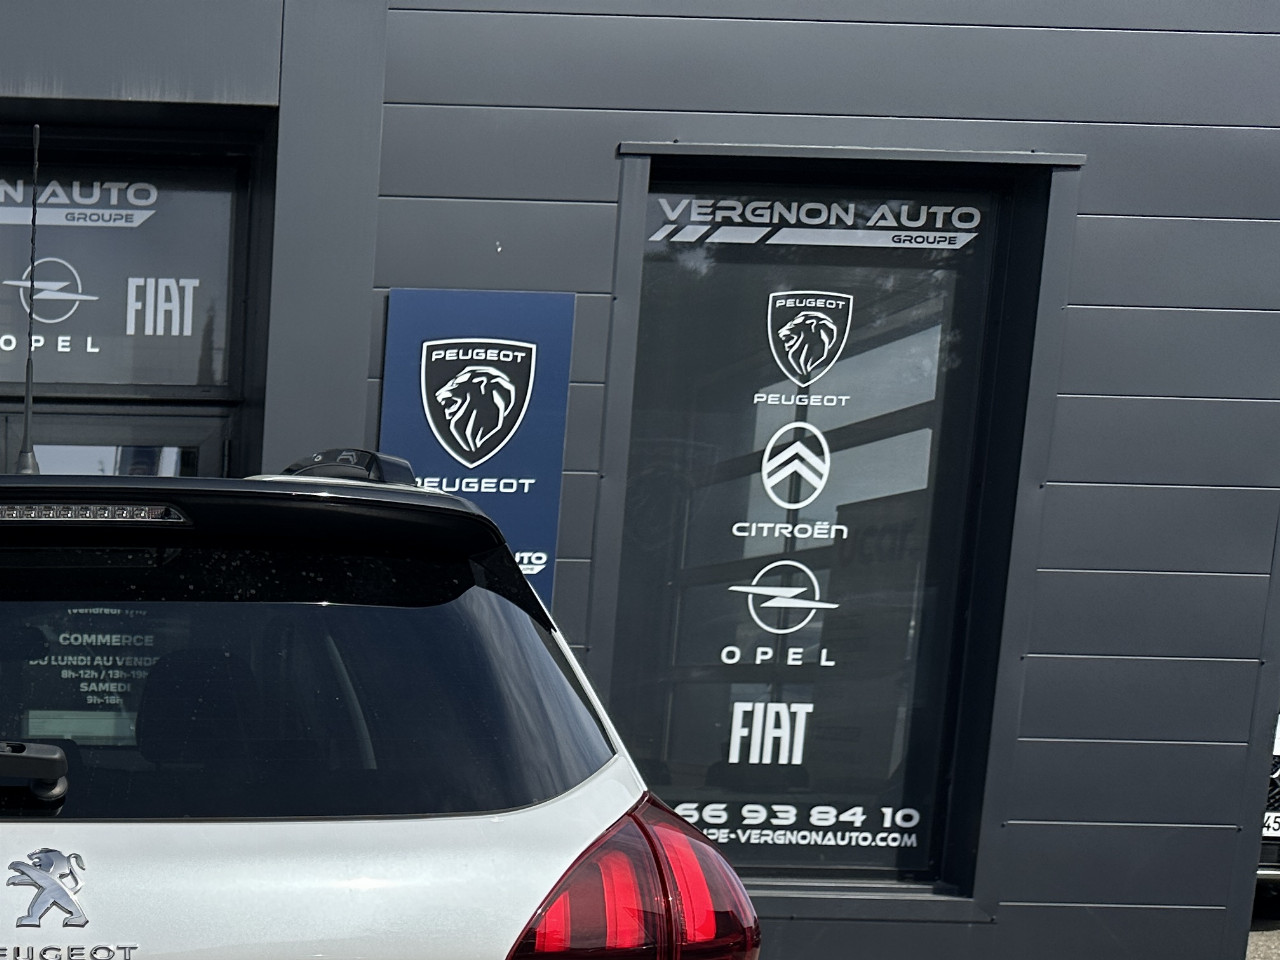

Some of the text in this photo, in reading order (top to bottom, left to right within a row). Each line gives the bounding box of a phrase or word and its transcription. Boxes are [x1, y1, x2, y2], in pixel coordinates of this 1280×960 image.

[34, 181, 158, 206] AUTO
[65, 212, 135, 223] GROUPE
[658, 198, 981, 228] VERGNON AUTO
[891, 234, 958, 245] GROUPE
[126, 277, 200, 336] FIAT
[775, 298, 846, 309] PEUGEOT
[0, 335, 99, 353] OPEL
[431, 349, 526, 362] PEUGEOT
[753, 393, 850, 406] PEUGEOT
[58, 633, 154, 646] COMMERCE
[51, 656, 90, 666] LUNDI
[93, 656, 113, 666] AU
[721, 645, 836, 666] OPEL
[61, 670, 98, 679] 8h-12h
[79, 682, 131, 692] SAMEDI
[728, 701, 814, 764] FIAT
[673, 802, 920, 828] 66 93 84 10
